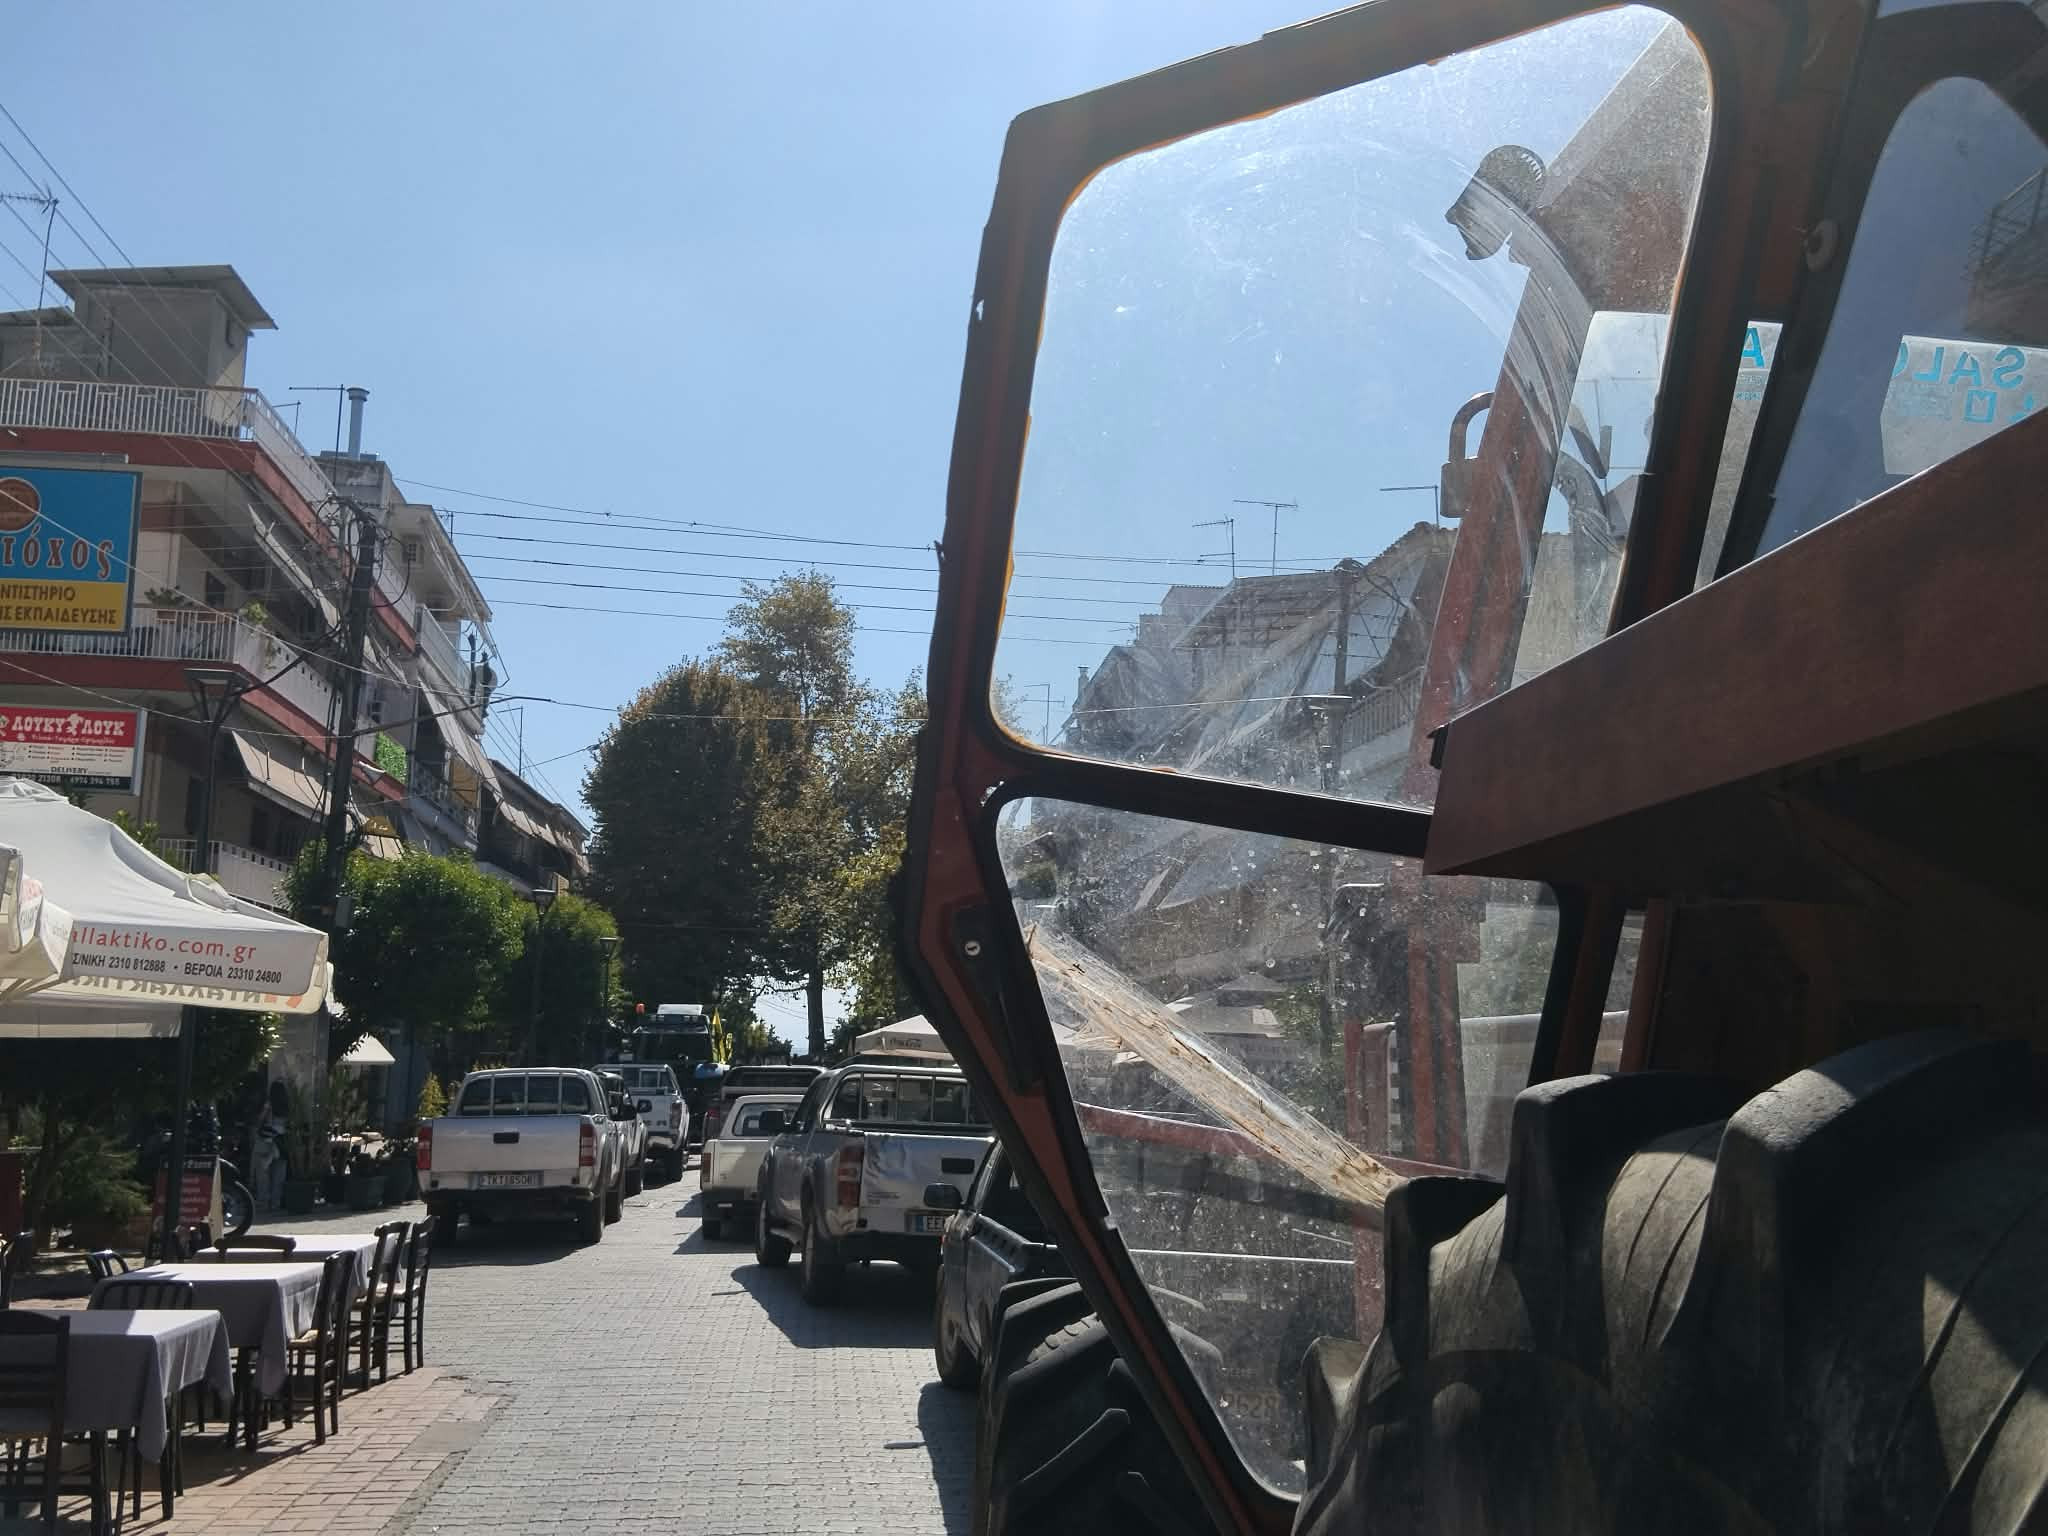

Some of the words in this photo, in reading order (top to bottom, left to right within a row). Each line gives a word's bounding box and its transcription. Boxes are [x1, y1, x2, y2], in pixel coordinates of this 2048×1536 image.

[15, 606, 117, 625] ΕΚΠΑΙΔΕΥΣΗΣ
[109, 956, 131, 969] 2310
[184, 962, 223, 979] ΒΕΡΟΙΑ
[227, 966, 254, 982] 23310
[256, 969, 282, 985] 24800
